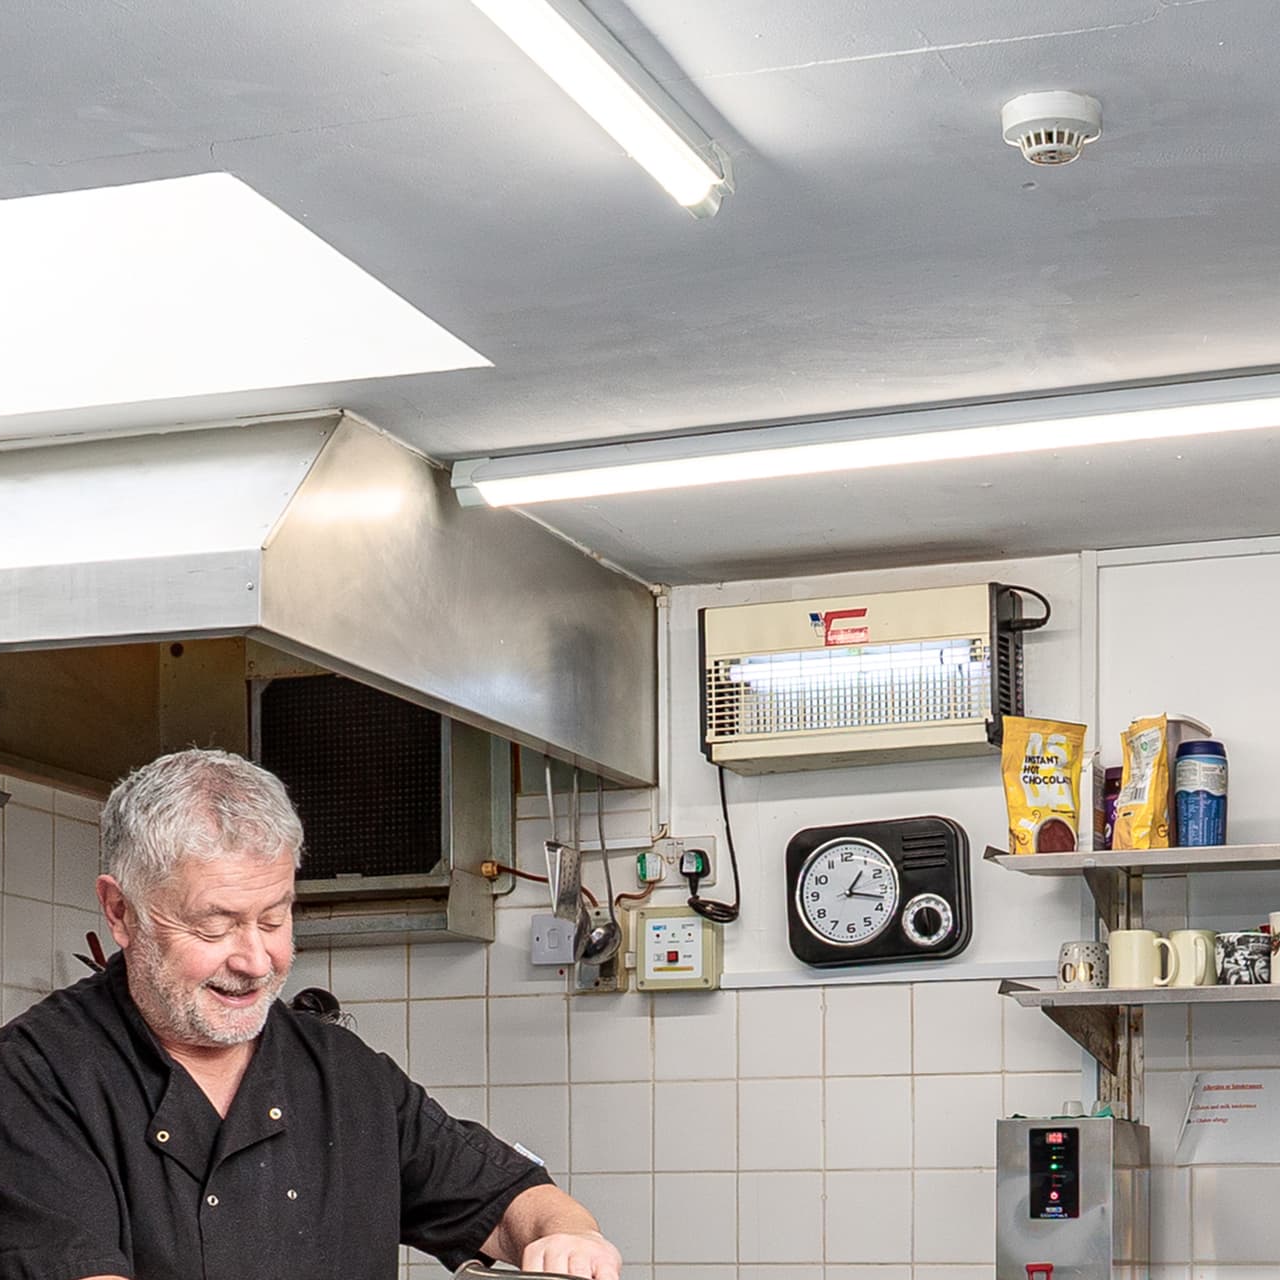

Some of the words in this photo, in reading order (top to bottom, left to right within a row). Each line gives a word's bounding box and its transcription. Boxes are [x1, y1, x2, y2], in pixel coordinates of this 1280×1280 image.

[1024, 755, 1059, 766] INSTANT
[1023, 765, 1039, 775] HOT
[1022, 775, 1073, 785] CHOCOLA
[840, 851, 854, 862] 12
[827, 859, 835, 870] 11
[872, 868, 883, 879] 2
[814, 874, 829, 886] 10
[810, 891, 820, 902] 9
[874, 902, 884, 912] 4
[817, 908, 827, 919] 8
[830, 920, 839, 931] 7
[863, 916, 872, 928] 5
[846, 923, 856, 934] 6
